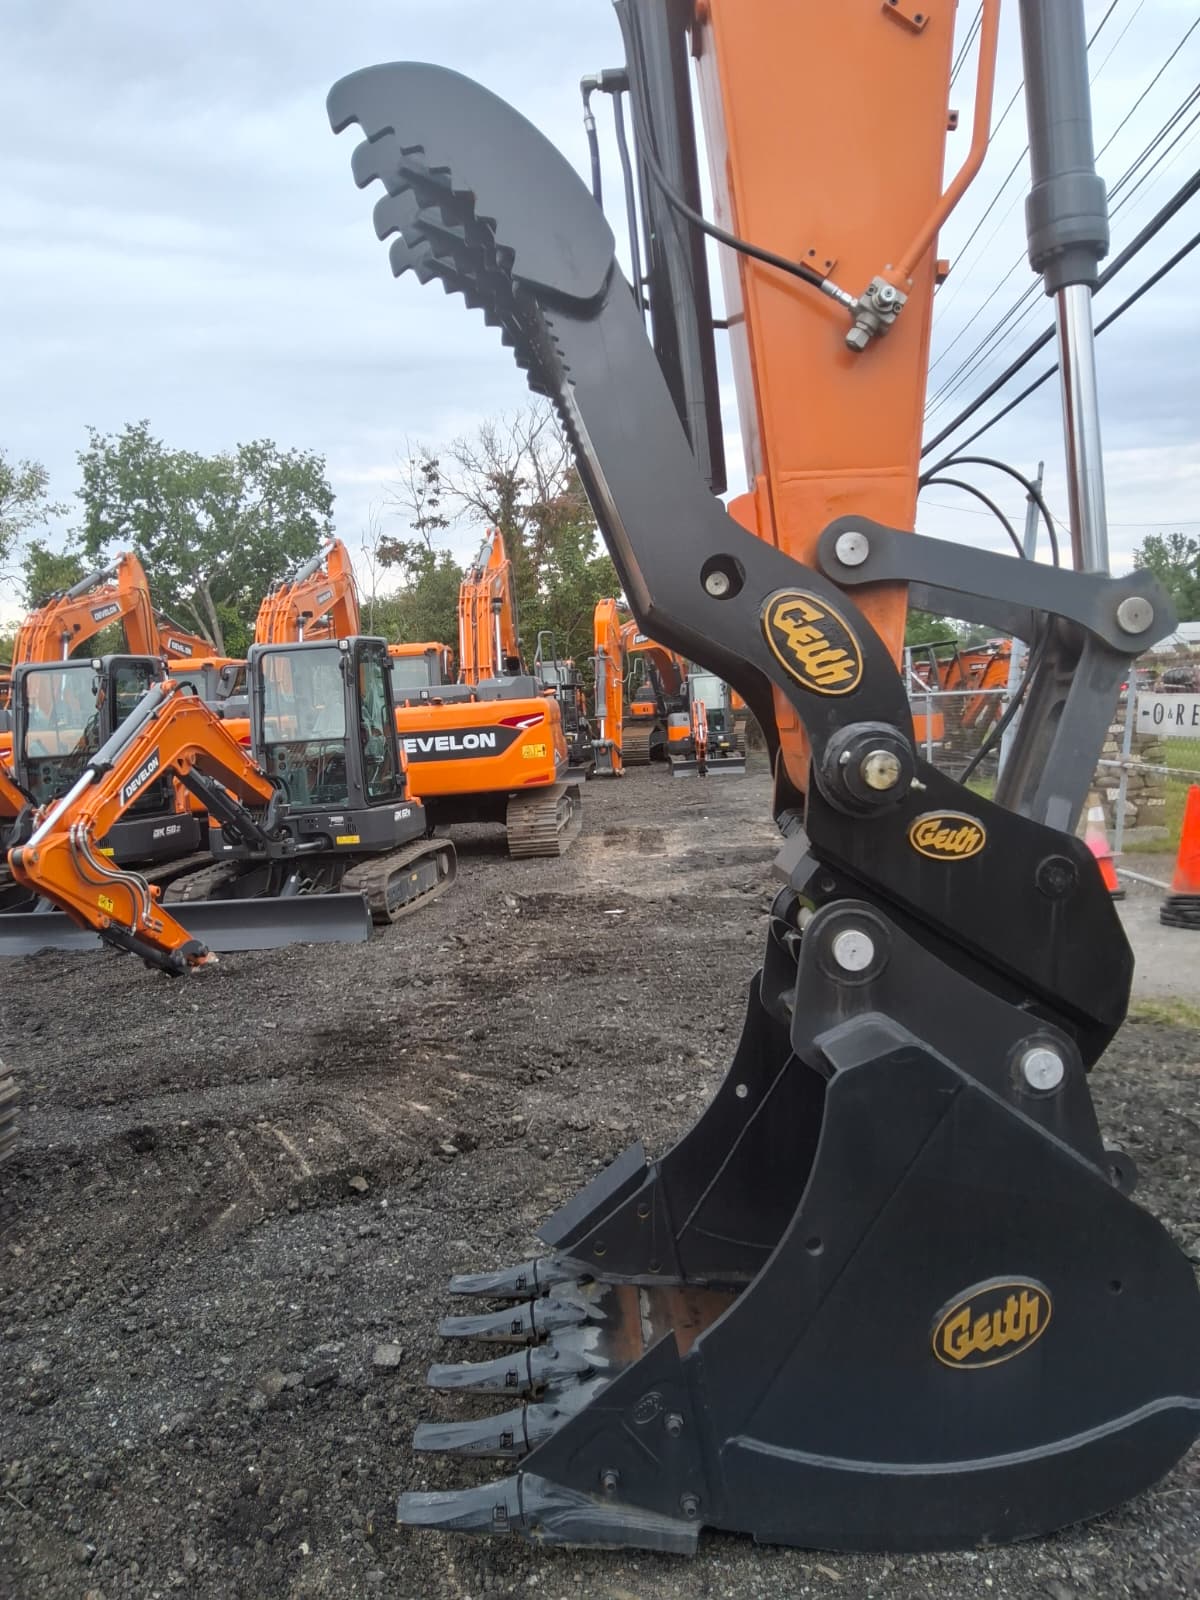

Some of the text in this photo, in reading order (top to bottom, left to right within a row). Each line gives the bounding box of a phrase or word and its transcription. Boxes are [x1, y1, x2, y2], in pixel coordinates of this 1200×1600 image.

[402, 733, 497, 754] EVELON
[125, 756, 159, 797] DEVELON
[943, 1290, 1040, 1361] Geith
